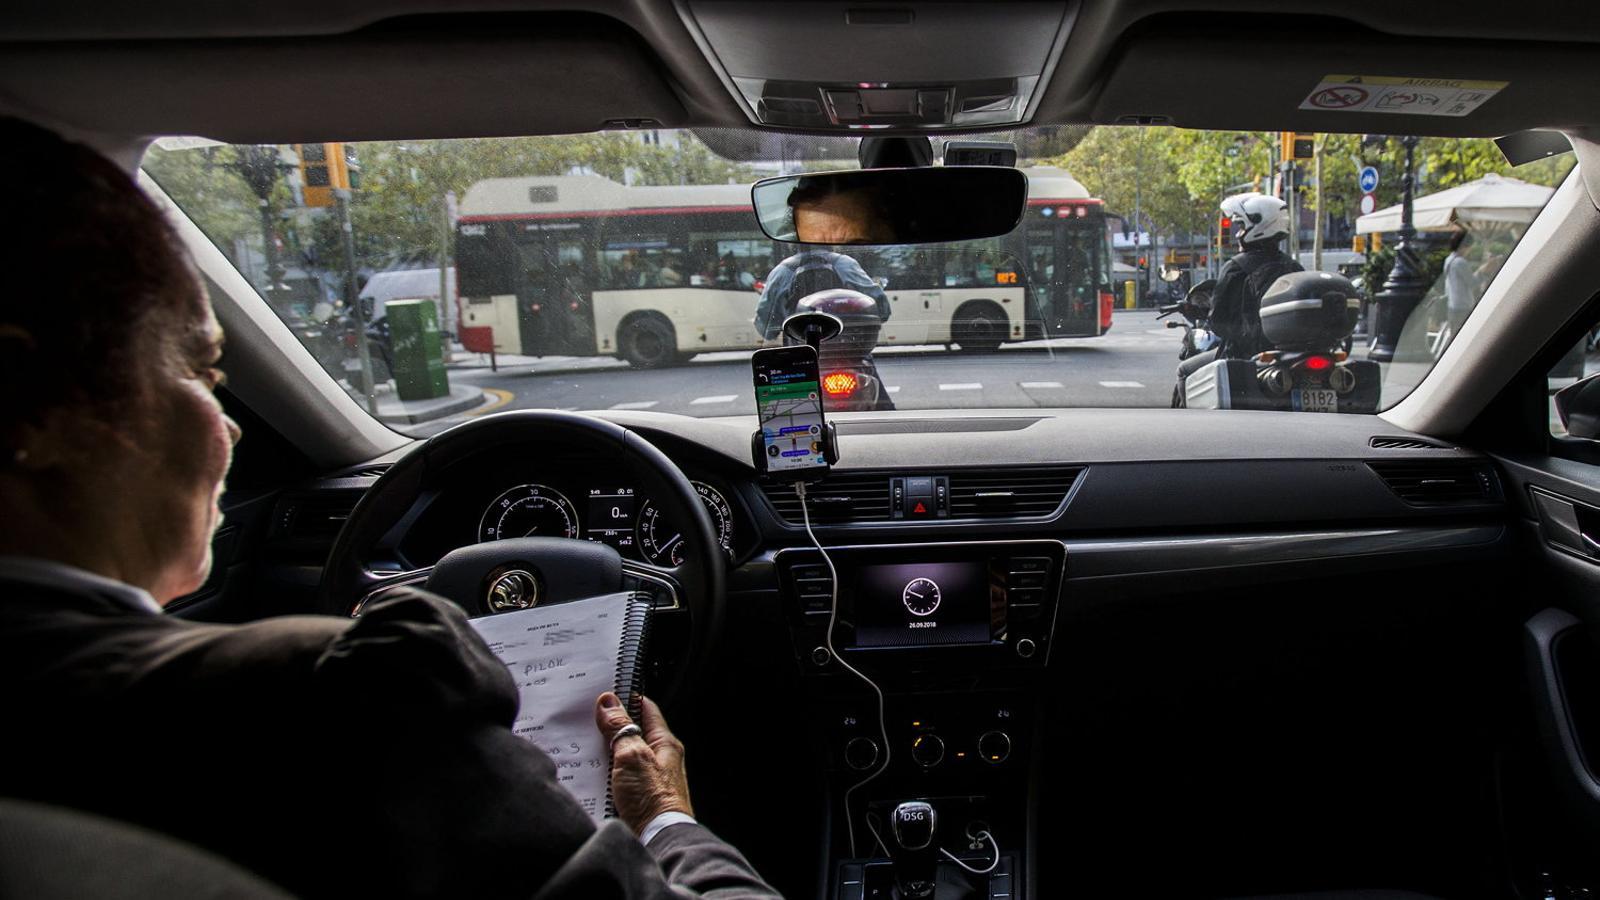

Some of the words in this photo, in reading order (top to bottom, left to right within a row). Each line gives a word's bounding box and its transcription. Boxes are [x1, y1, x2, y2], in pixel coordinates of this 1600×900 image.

[1404, 78, 1462, 88] AIRBAG
[1302, 392, 1334, 406] 8182
[612, 507, 619, 518] 0
[904, 812, 924, 821] DSG
